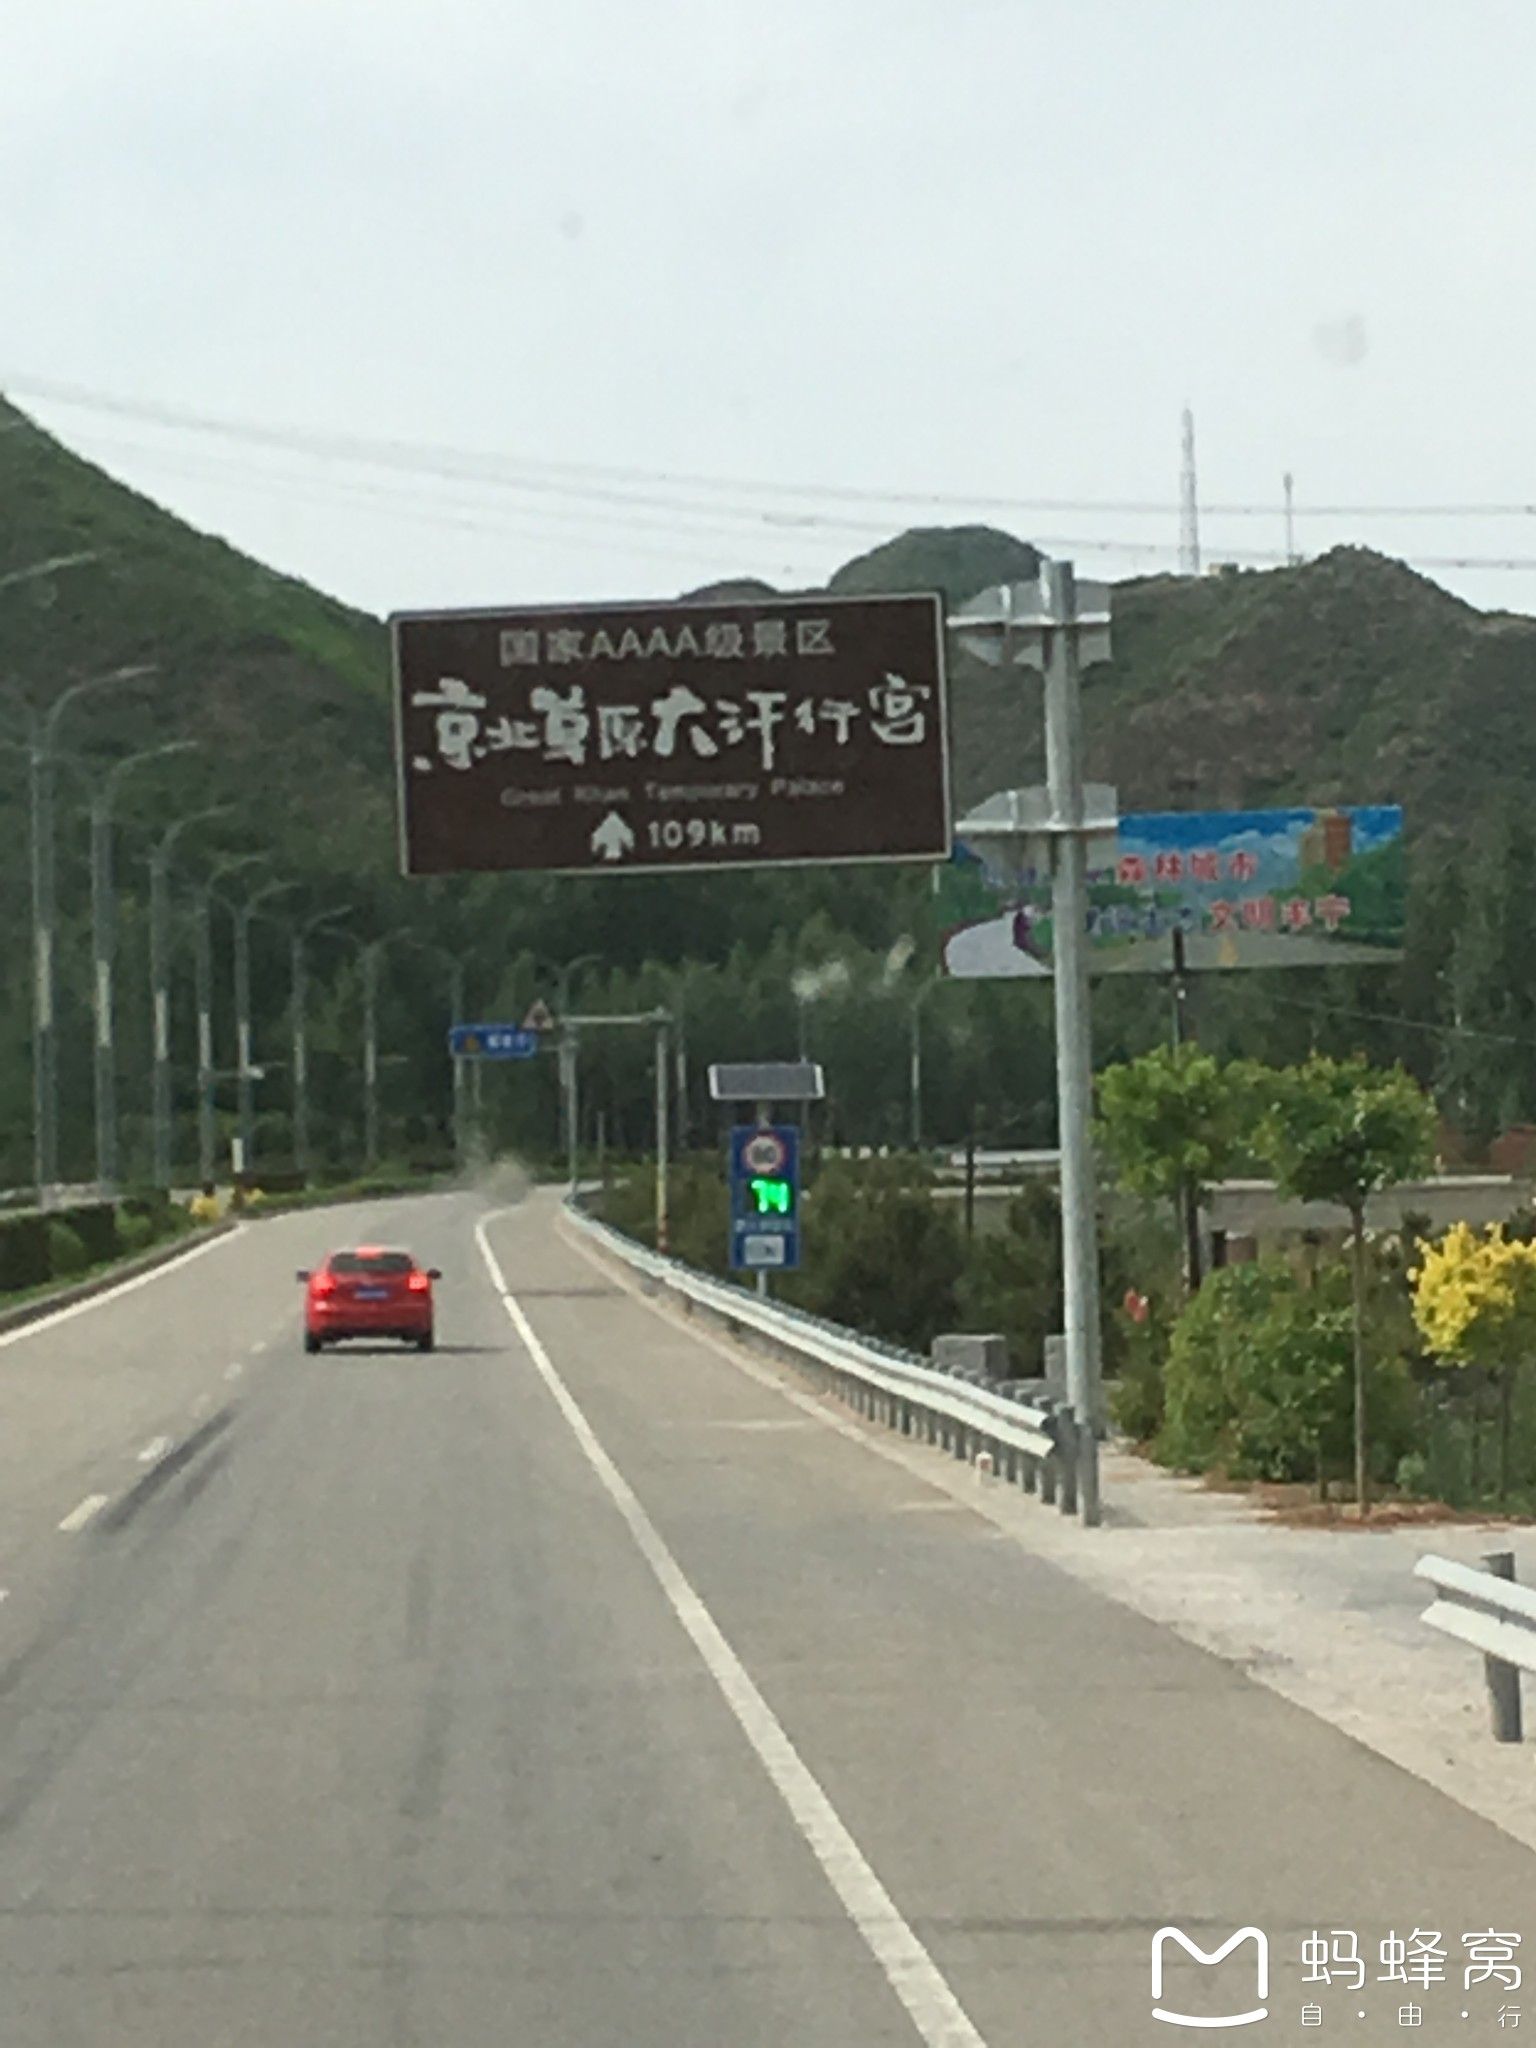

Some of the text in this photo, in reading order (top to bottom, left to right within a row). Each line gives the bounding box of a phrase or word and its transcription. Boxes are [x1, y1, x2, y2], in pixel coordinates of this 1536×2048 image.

[500, 619, 836, 667] 国家AAAA级景区
[648, 818, 761, 848] 109km
